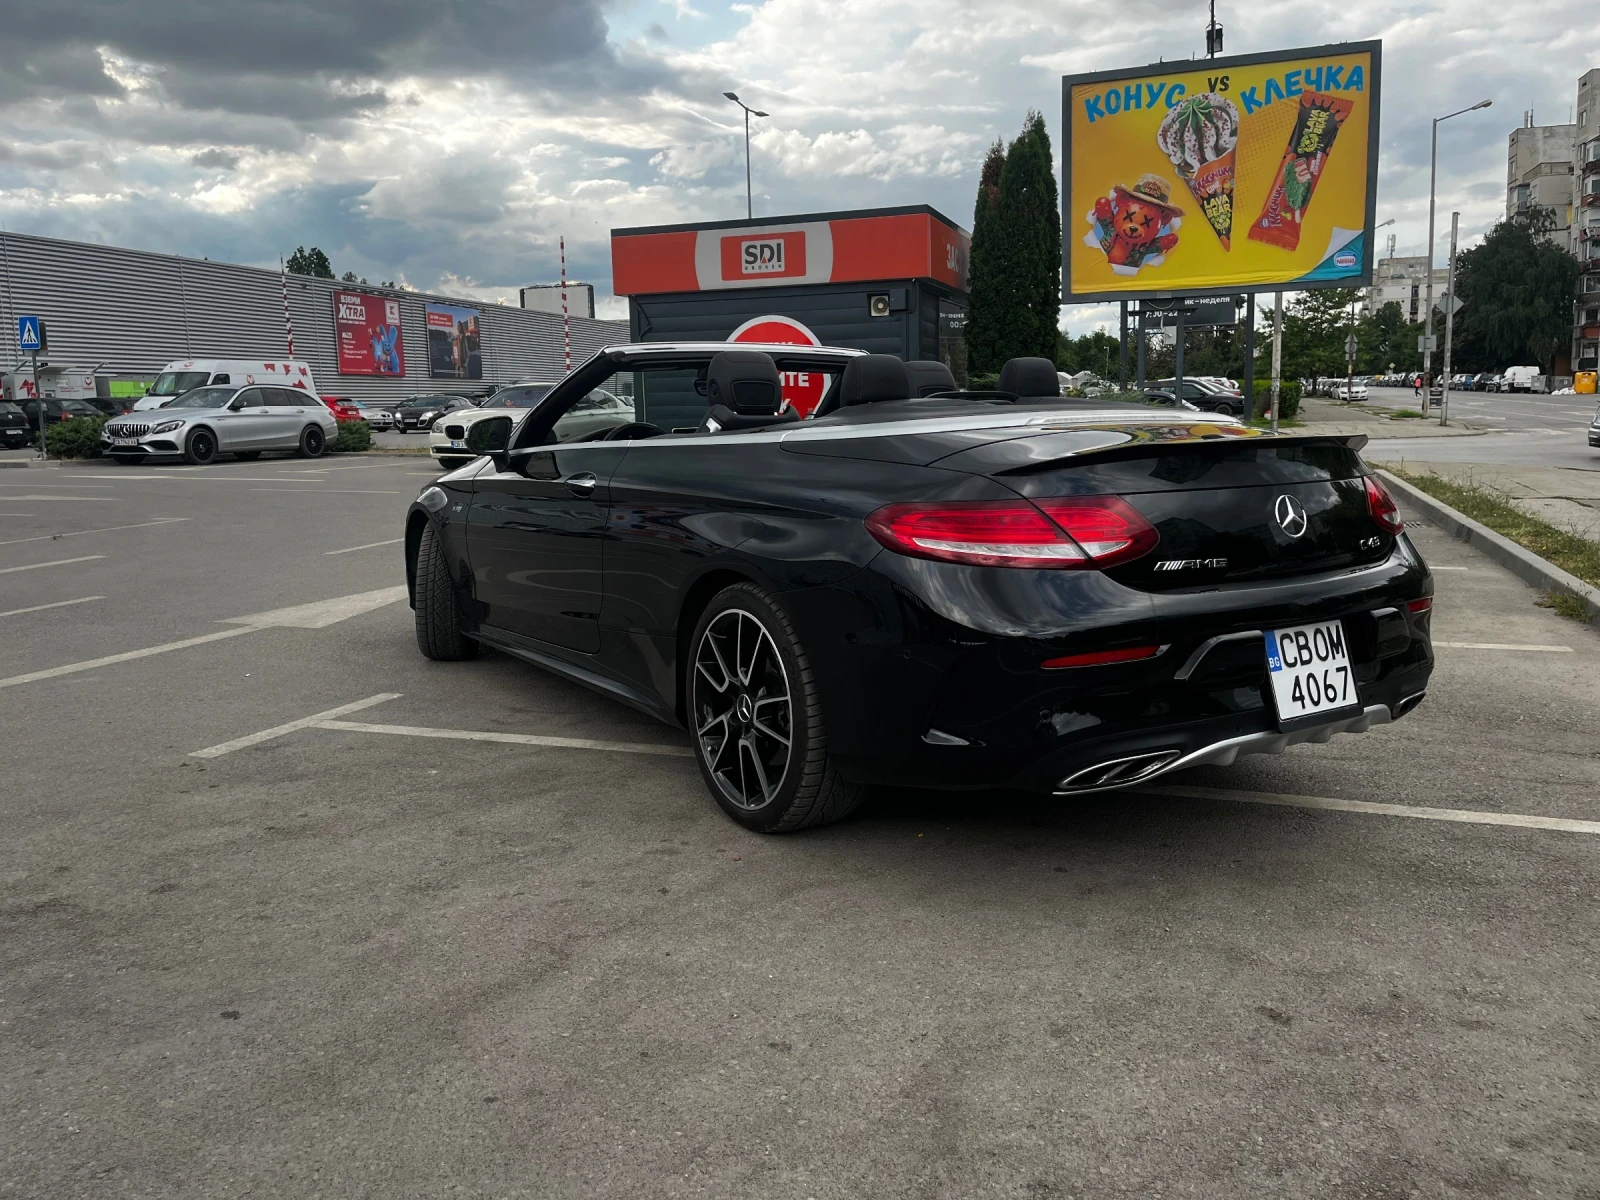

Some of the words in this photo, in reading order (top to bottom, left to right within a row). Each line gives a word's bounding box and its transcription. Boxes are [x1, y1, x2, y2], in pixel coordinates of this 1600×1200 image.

[1084, 83, 1186, 124] КОНУС
[1207, 75, 1230, 93] VS
[1239, 65, 1364, 115] КЛЕЧКА
[1306, 109, 1320, 132] LAVA
[1313, 111, 1330, 134] BEAR
[1191, 166, 1233, 197] MAGNUM
[1203, 194, 1230, 210] LAVA
[1206, 203, 1232, 218] BEAR
[744, 243, 782, 265] SDI
[340, 295, 361, 304] ВЗЕМИ
[338, 304, 365, 319] XTRA
[1175, 558, 1228, 570] AMG
[1279, 624, 1345, 669] CBOM
[1268, 656, 1280, 668] BG
[1291, 666, 1349, 710] 4067
